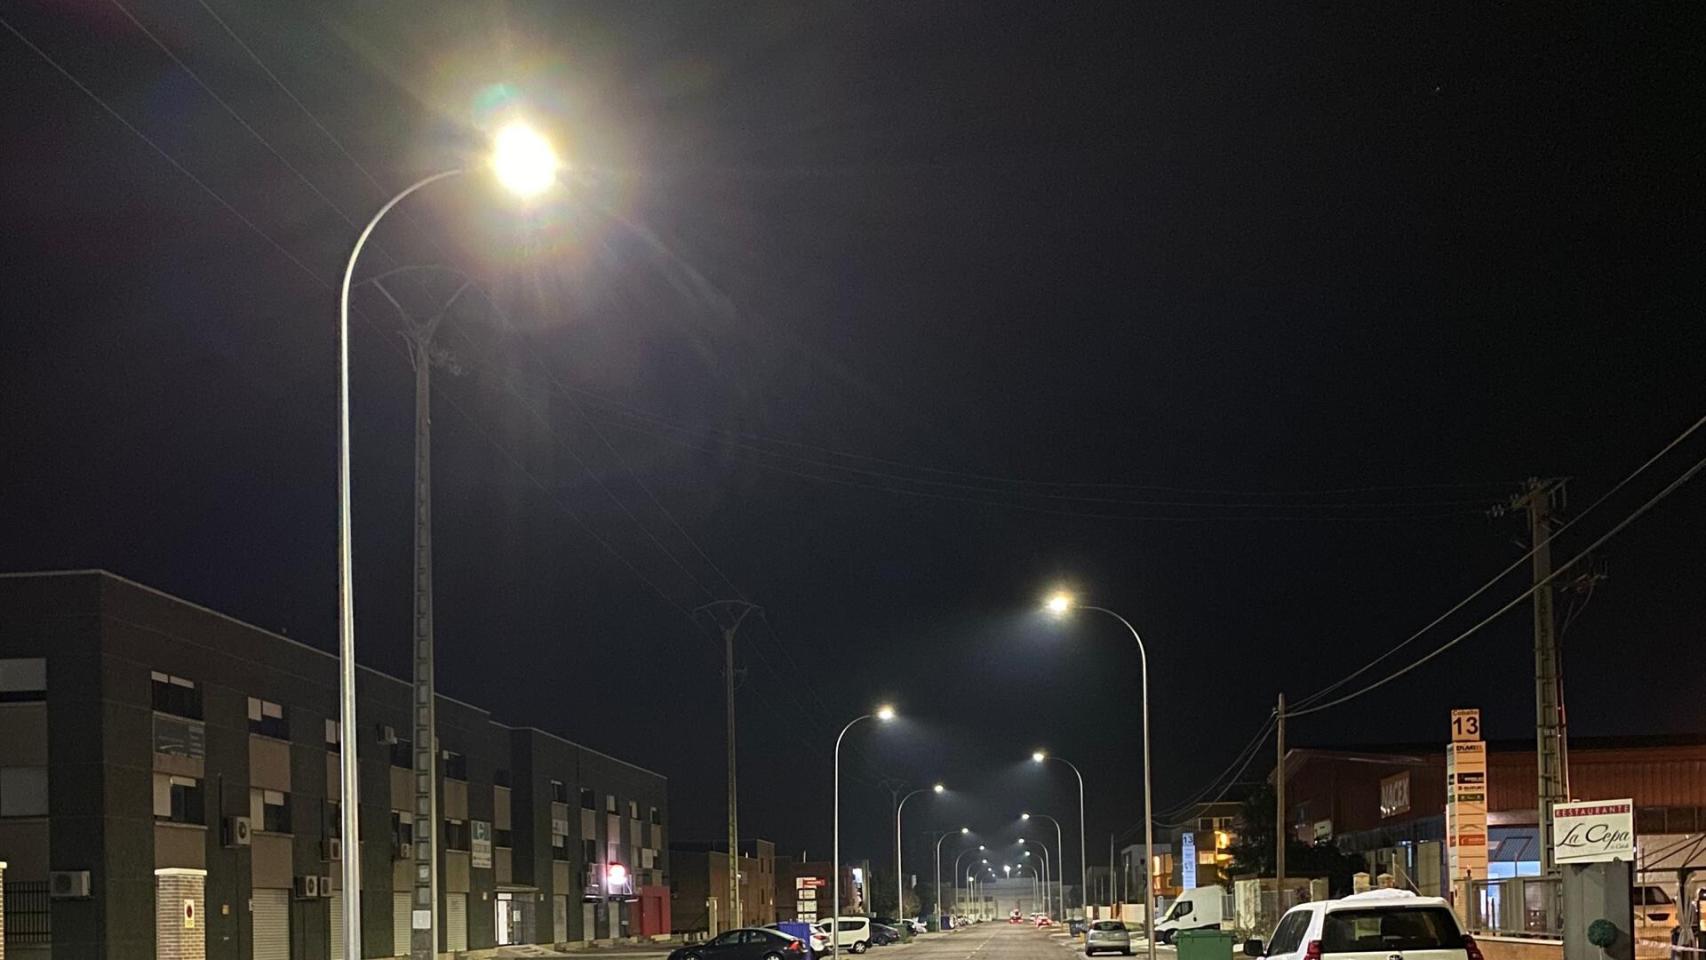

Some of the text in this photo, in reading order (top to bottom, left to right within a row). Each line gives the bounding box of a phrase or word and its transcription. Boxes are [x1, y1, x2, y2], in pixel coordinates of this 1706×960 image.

[1453, 716, 1478, 735] 13
[1555, 805, 1629, 817] RESTAURANTE
[1183, 836, 1193, 844] 13
[1555, 822, 1630, 850] La Cepa
